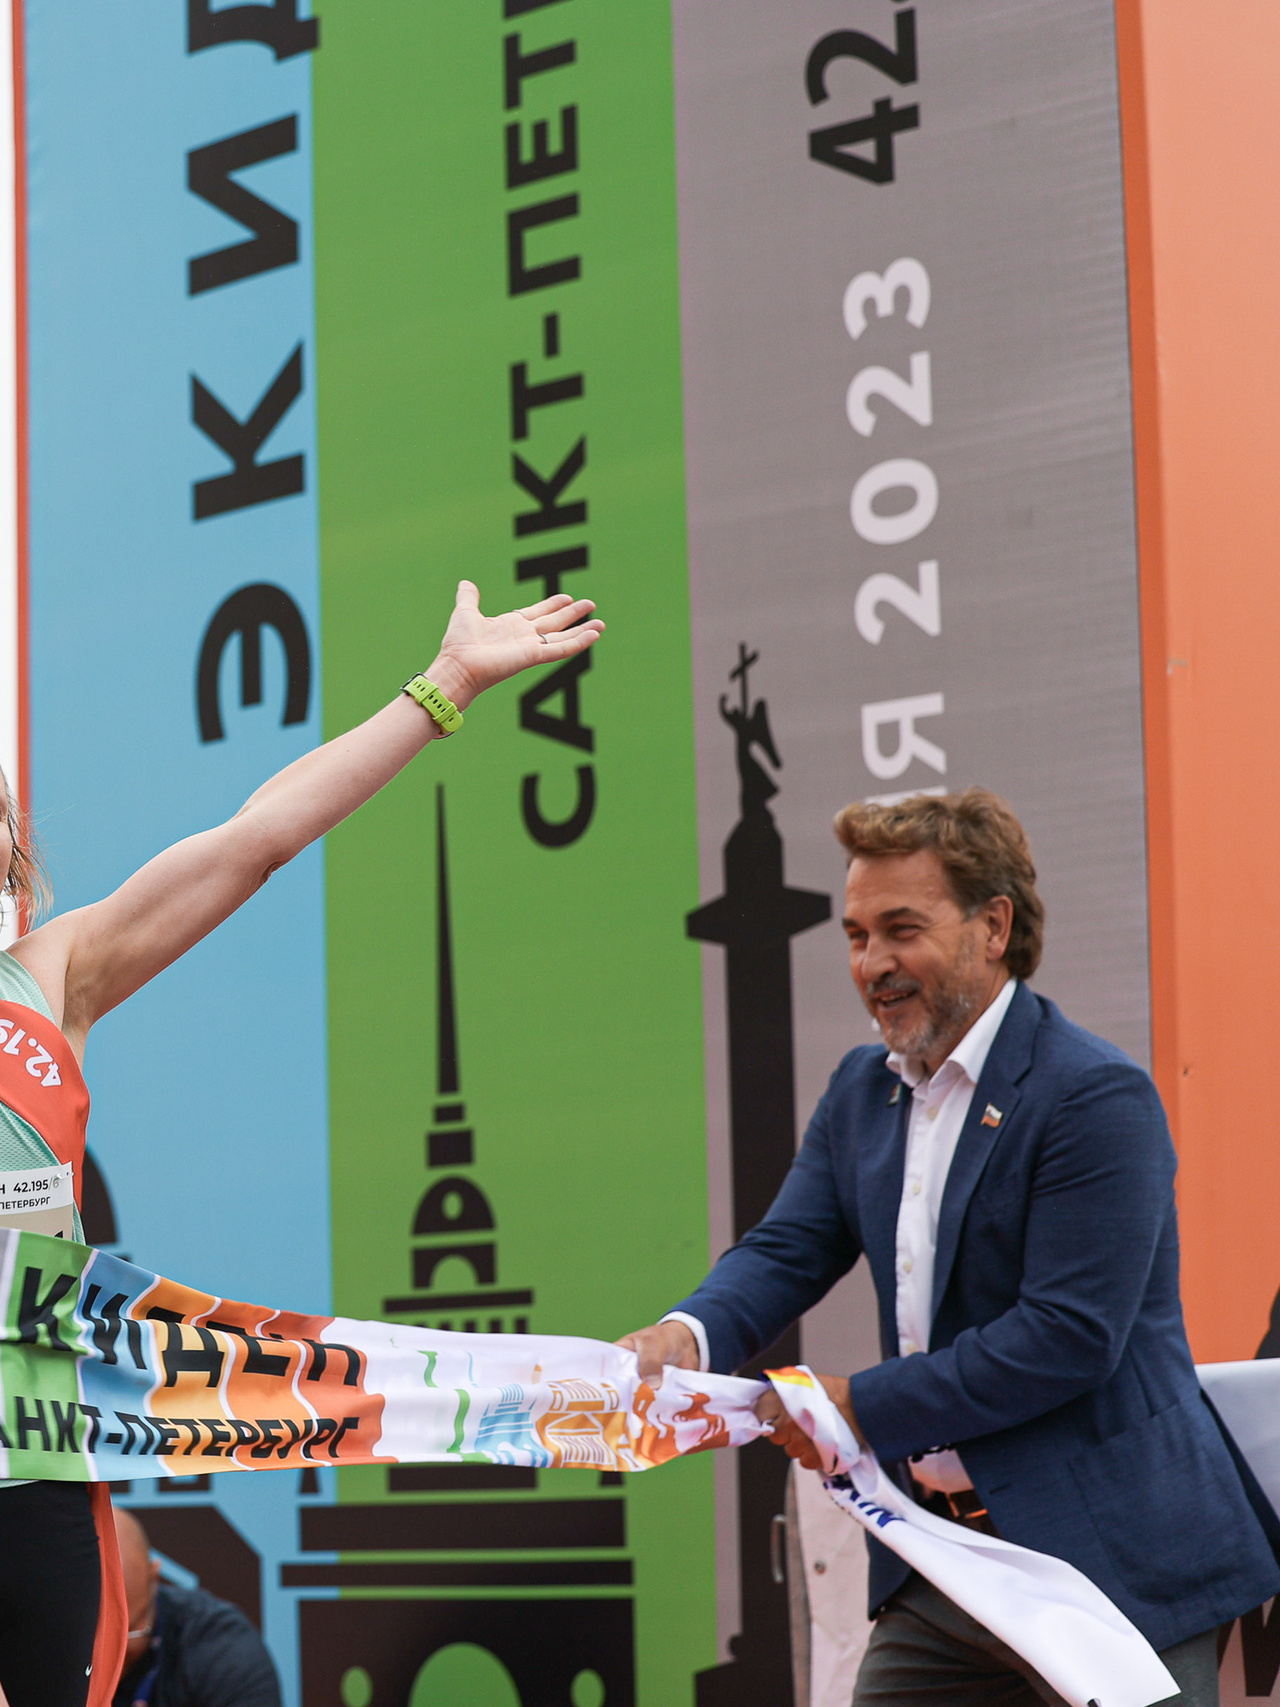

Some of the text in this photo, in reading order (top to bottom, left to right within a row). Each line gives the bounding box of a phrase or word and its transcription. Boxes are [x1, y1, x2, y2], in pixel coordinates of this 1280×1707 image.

[805, 0, 919, 186] 42
[504, 0, 597, 849] САНКТ-ПЕТ
[843, 257, 940, 645] 2023
